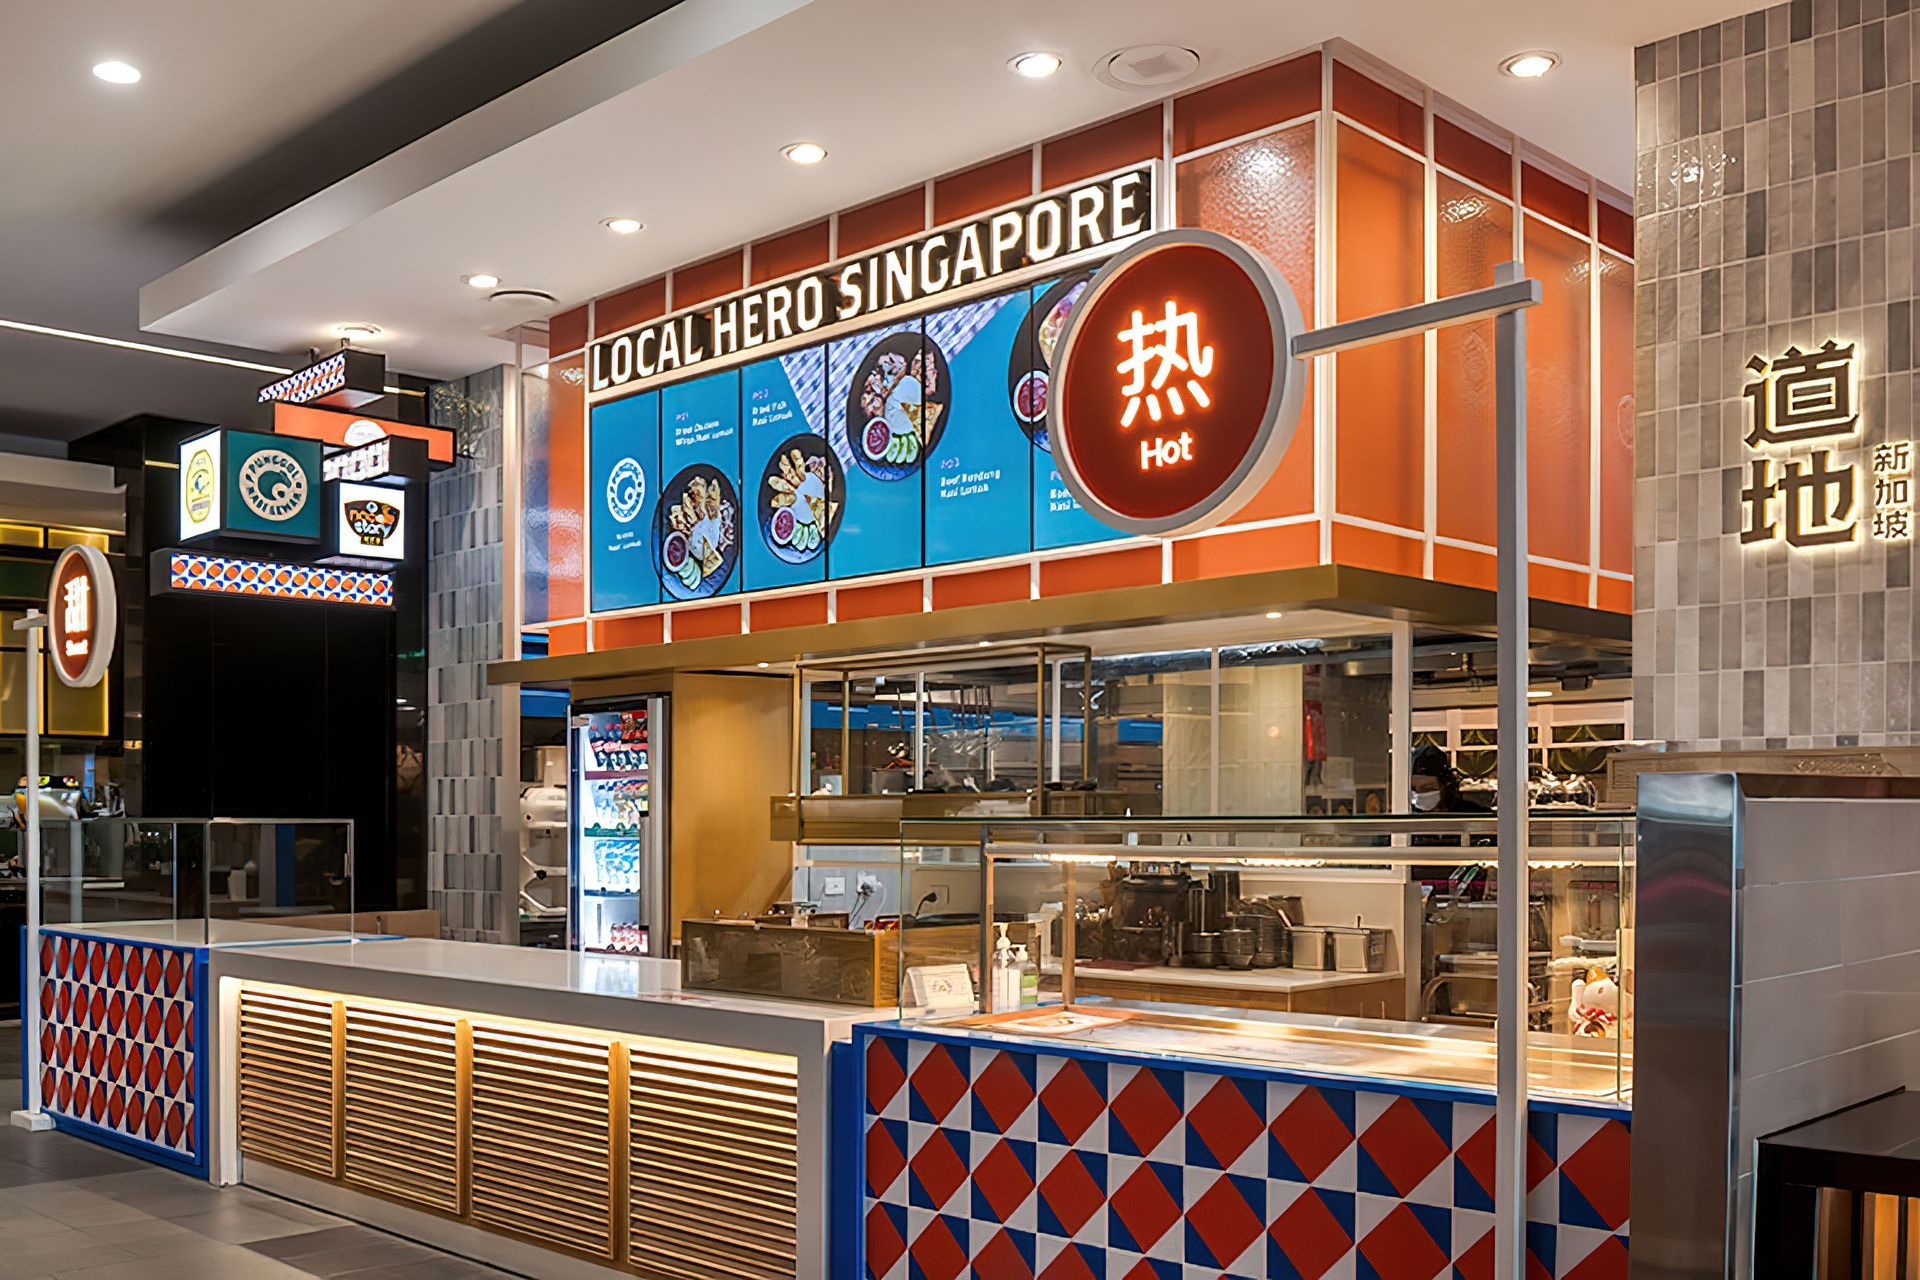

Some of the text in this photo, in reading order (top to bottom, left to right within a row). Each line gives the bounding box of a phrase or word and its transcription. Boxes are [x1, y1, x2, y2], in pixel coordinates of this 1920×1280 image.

[592, 172, 1144, 391] LOCAL HERO SINGAPORE
[1116, 300, 1214, 428] 热
[1140, 432, 1193, 470] Hot
[1740, 339, 1859, 548] 道地
[1873, 442, 1910, 538] 新加坡
